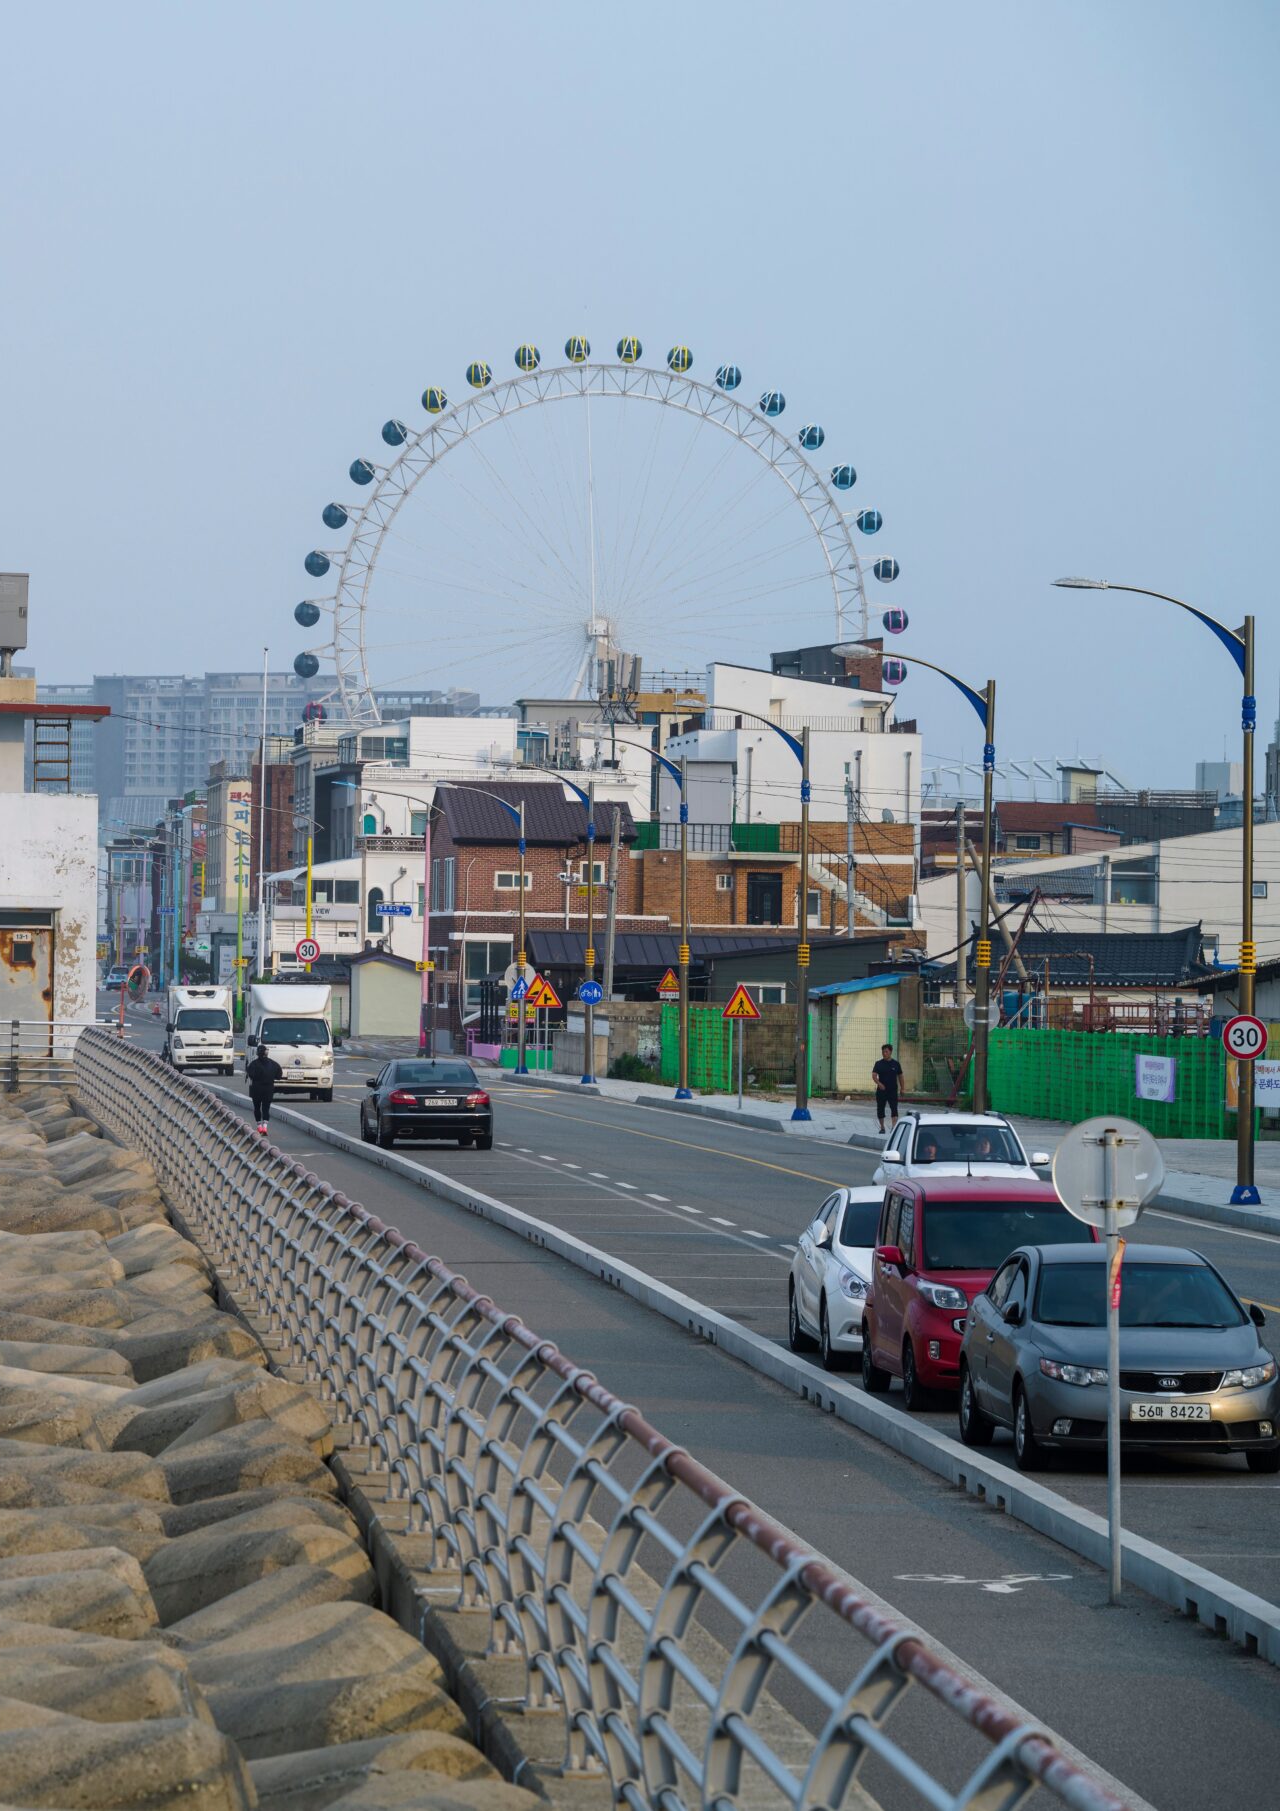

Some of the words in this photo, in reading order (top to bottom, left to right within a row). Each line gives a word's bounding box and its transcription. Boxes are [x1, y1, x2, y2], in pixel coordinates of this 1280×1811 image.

[315, 907, 331, 915] VIEW
[301, 945, 315, 957] 30
[1232, 1028, 1259, 1047] 30
[1139, 1405, 1163, 1418] 56마
[1170, 1405, 1203, 1418] 8422
